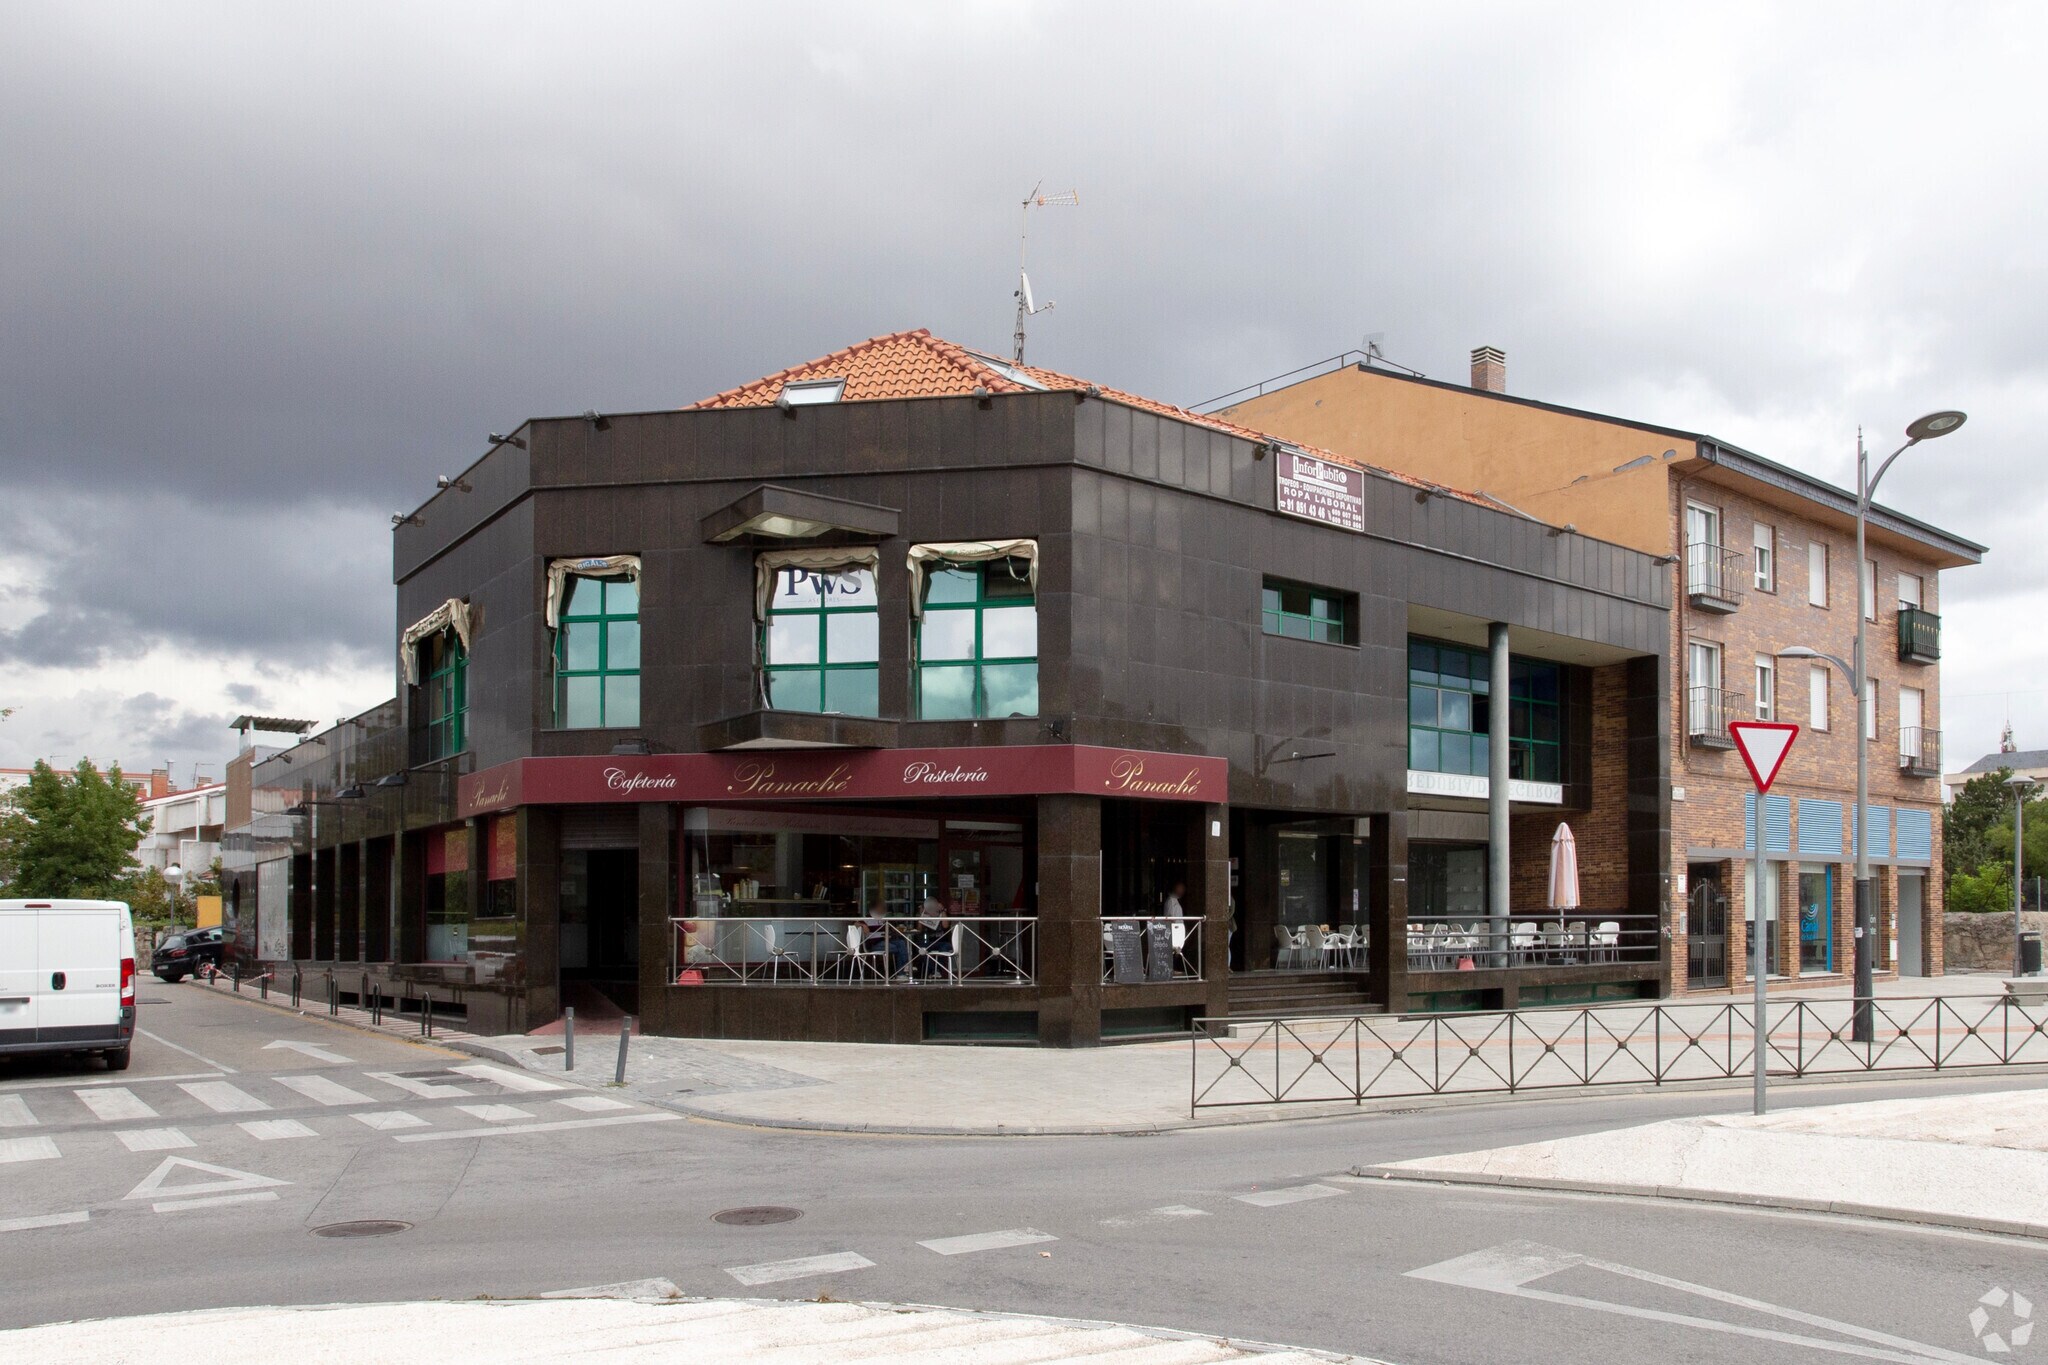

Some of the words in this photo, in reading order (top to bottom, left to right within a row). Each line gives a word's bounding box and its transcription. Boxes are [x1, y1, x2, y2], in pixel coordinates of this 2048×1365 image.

[1283, 486, 1310, 501] ROPA
[1314, 494, 1358, 513] LABORAL
[1286, 498, 1294, 511] 91
[1303, 483, 1335, 498] EQUIPACIONES
[1335, 491, 1362, 506] DEPORTIVAS
[603, 767, 677, 796] Cafetería
[727, 760, 854, 796] Panaché
[903, 761, 989, 785] Pastelería
[1105, 753, 1202, 796] Panaché
[469, 775, 509, 809] Panaché
